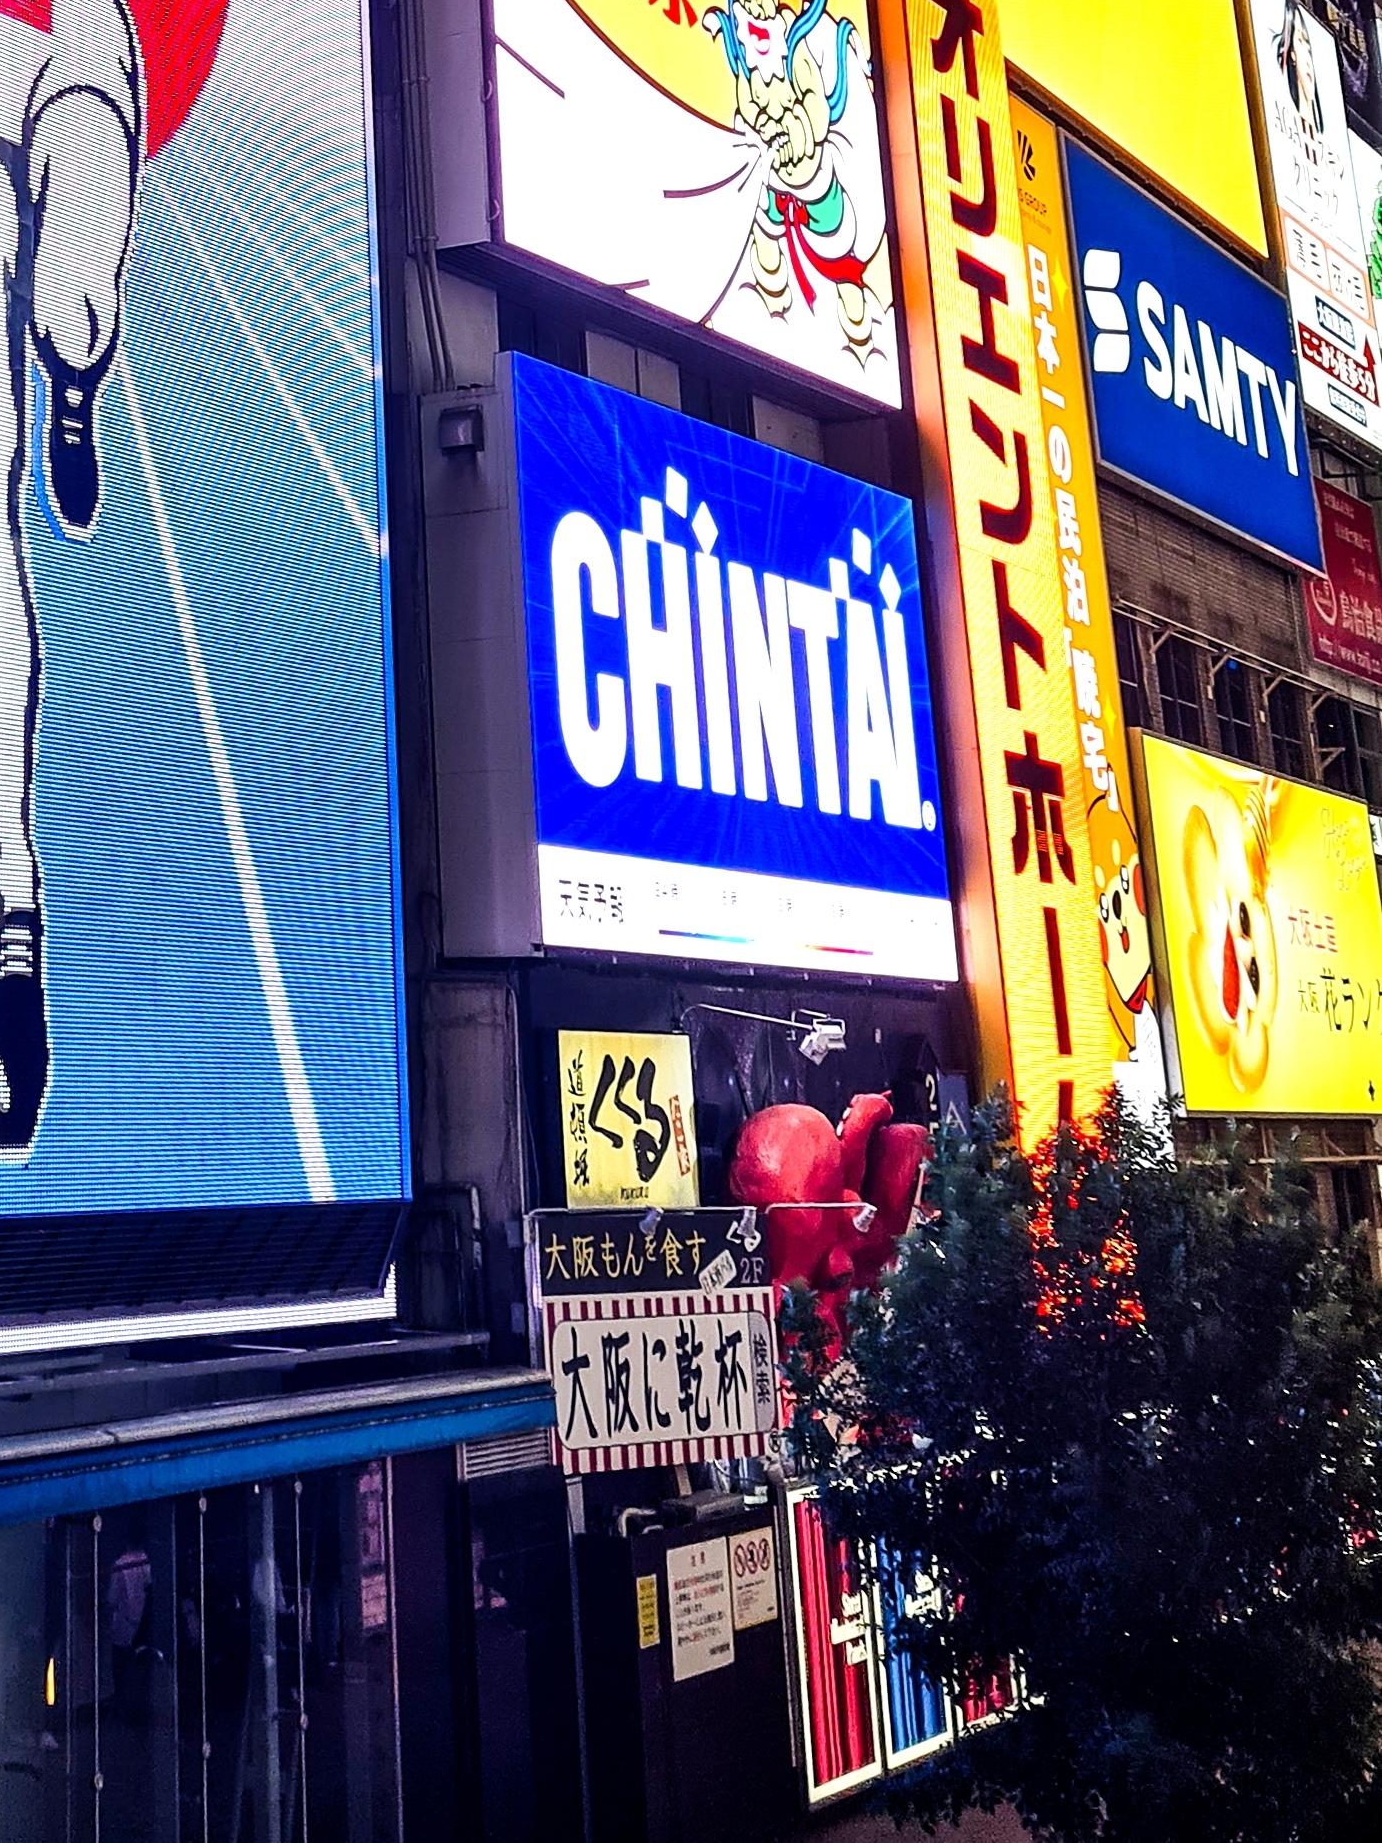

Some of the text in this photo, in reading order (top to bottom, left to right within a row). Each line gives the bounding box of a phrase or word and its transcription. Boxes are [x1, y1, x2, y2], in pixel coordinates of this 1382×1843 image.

[1136, 280, 1299, 478] SAMTY
[550, 466, 924, 831] CHINTAI
[587, 1053, 671, 1183] くくる
[544, 1230, 707, 1282] 大阪もんを食す
[739, 1256, 765, 1285] 2F
[561, 1317, 748, 1442] 大阪に乾杯
